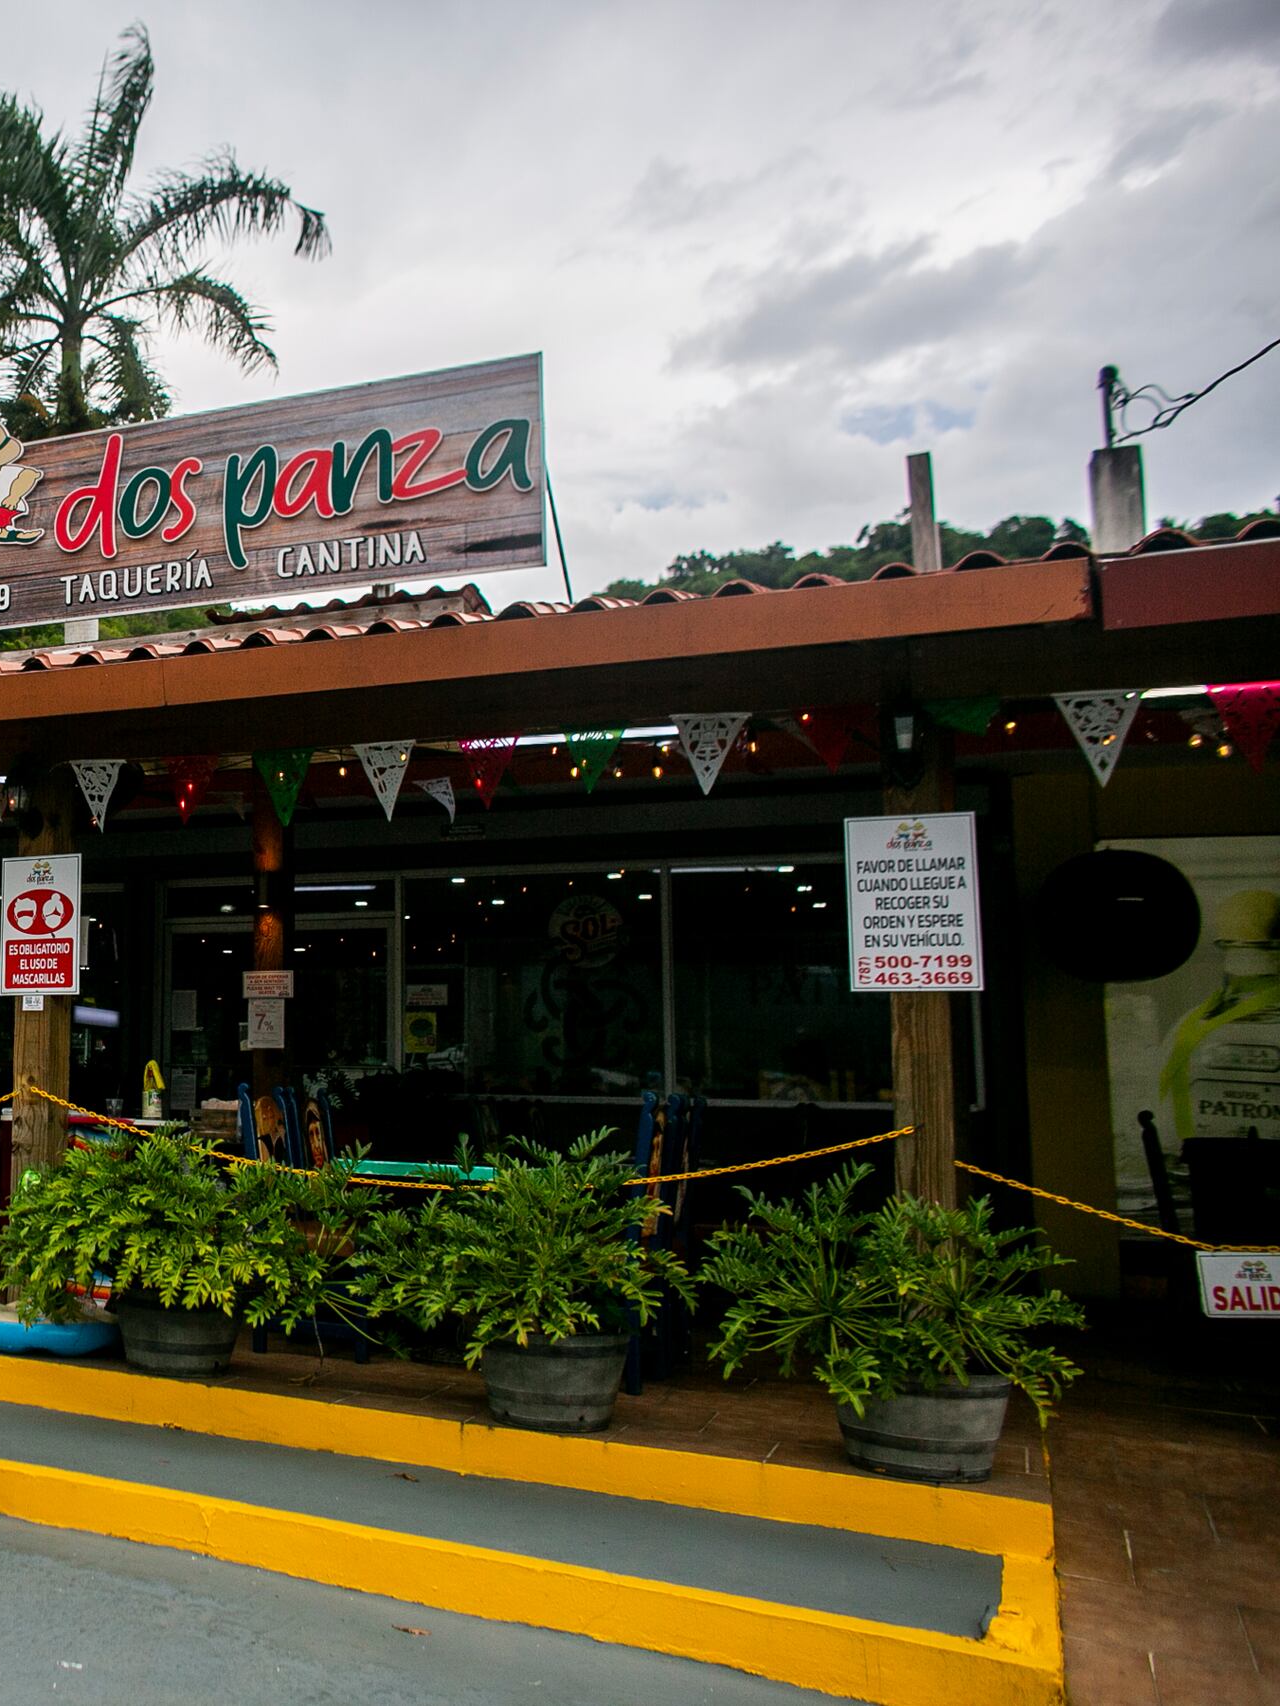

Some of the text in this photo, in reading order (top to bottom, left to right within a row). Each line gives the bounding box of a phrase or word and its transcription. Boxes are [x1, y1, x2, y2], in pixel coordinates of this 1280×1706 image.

[54, 418, 534, 569] dos panza
[59, 531, 426, 604] TAQUERÍA CANTINA
[857, 857, 965, 874] FAVOR DE LLAMAR
[857, 876, 967, 892] CUANDO LLEGUE A
[875, 895, 950, 910] RECOGER SU
[863, 913, 964, 929] ORDEN Y ESPERE
[864, 930, 965, 948] EN SU VEHÍCULO.
[9, 943, 70, 955] ES OBLIGATORIO
[20, 958, 58, 970] EL USO DE
[874, 954, 973, 969] 500-7199
[12, 973, 65, 984] MASCARILLAS
[874, 971, 973, 985] 463-3669
[255, 1013, 274, 1032] 7%
[1213, 1285, 1280, 1311] SALID
